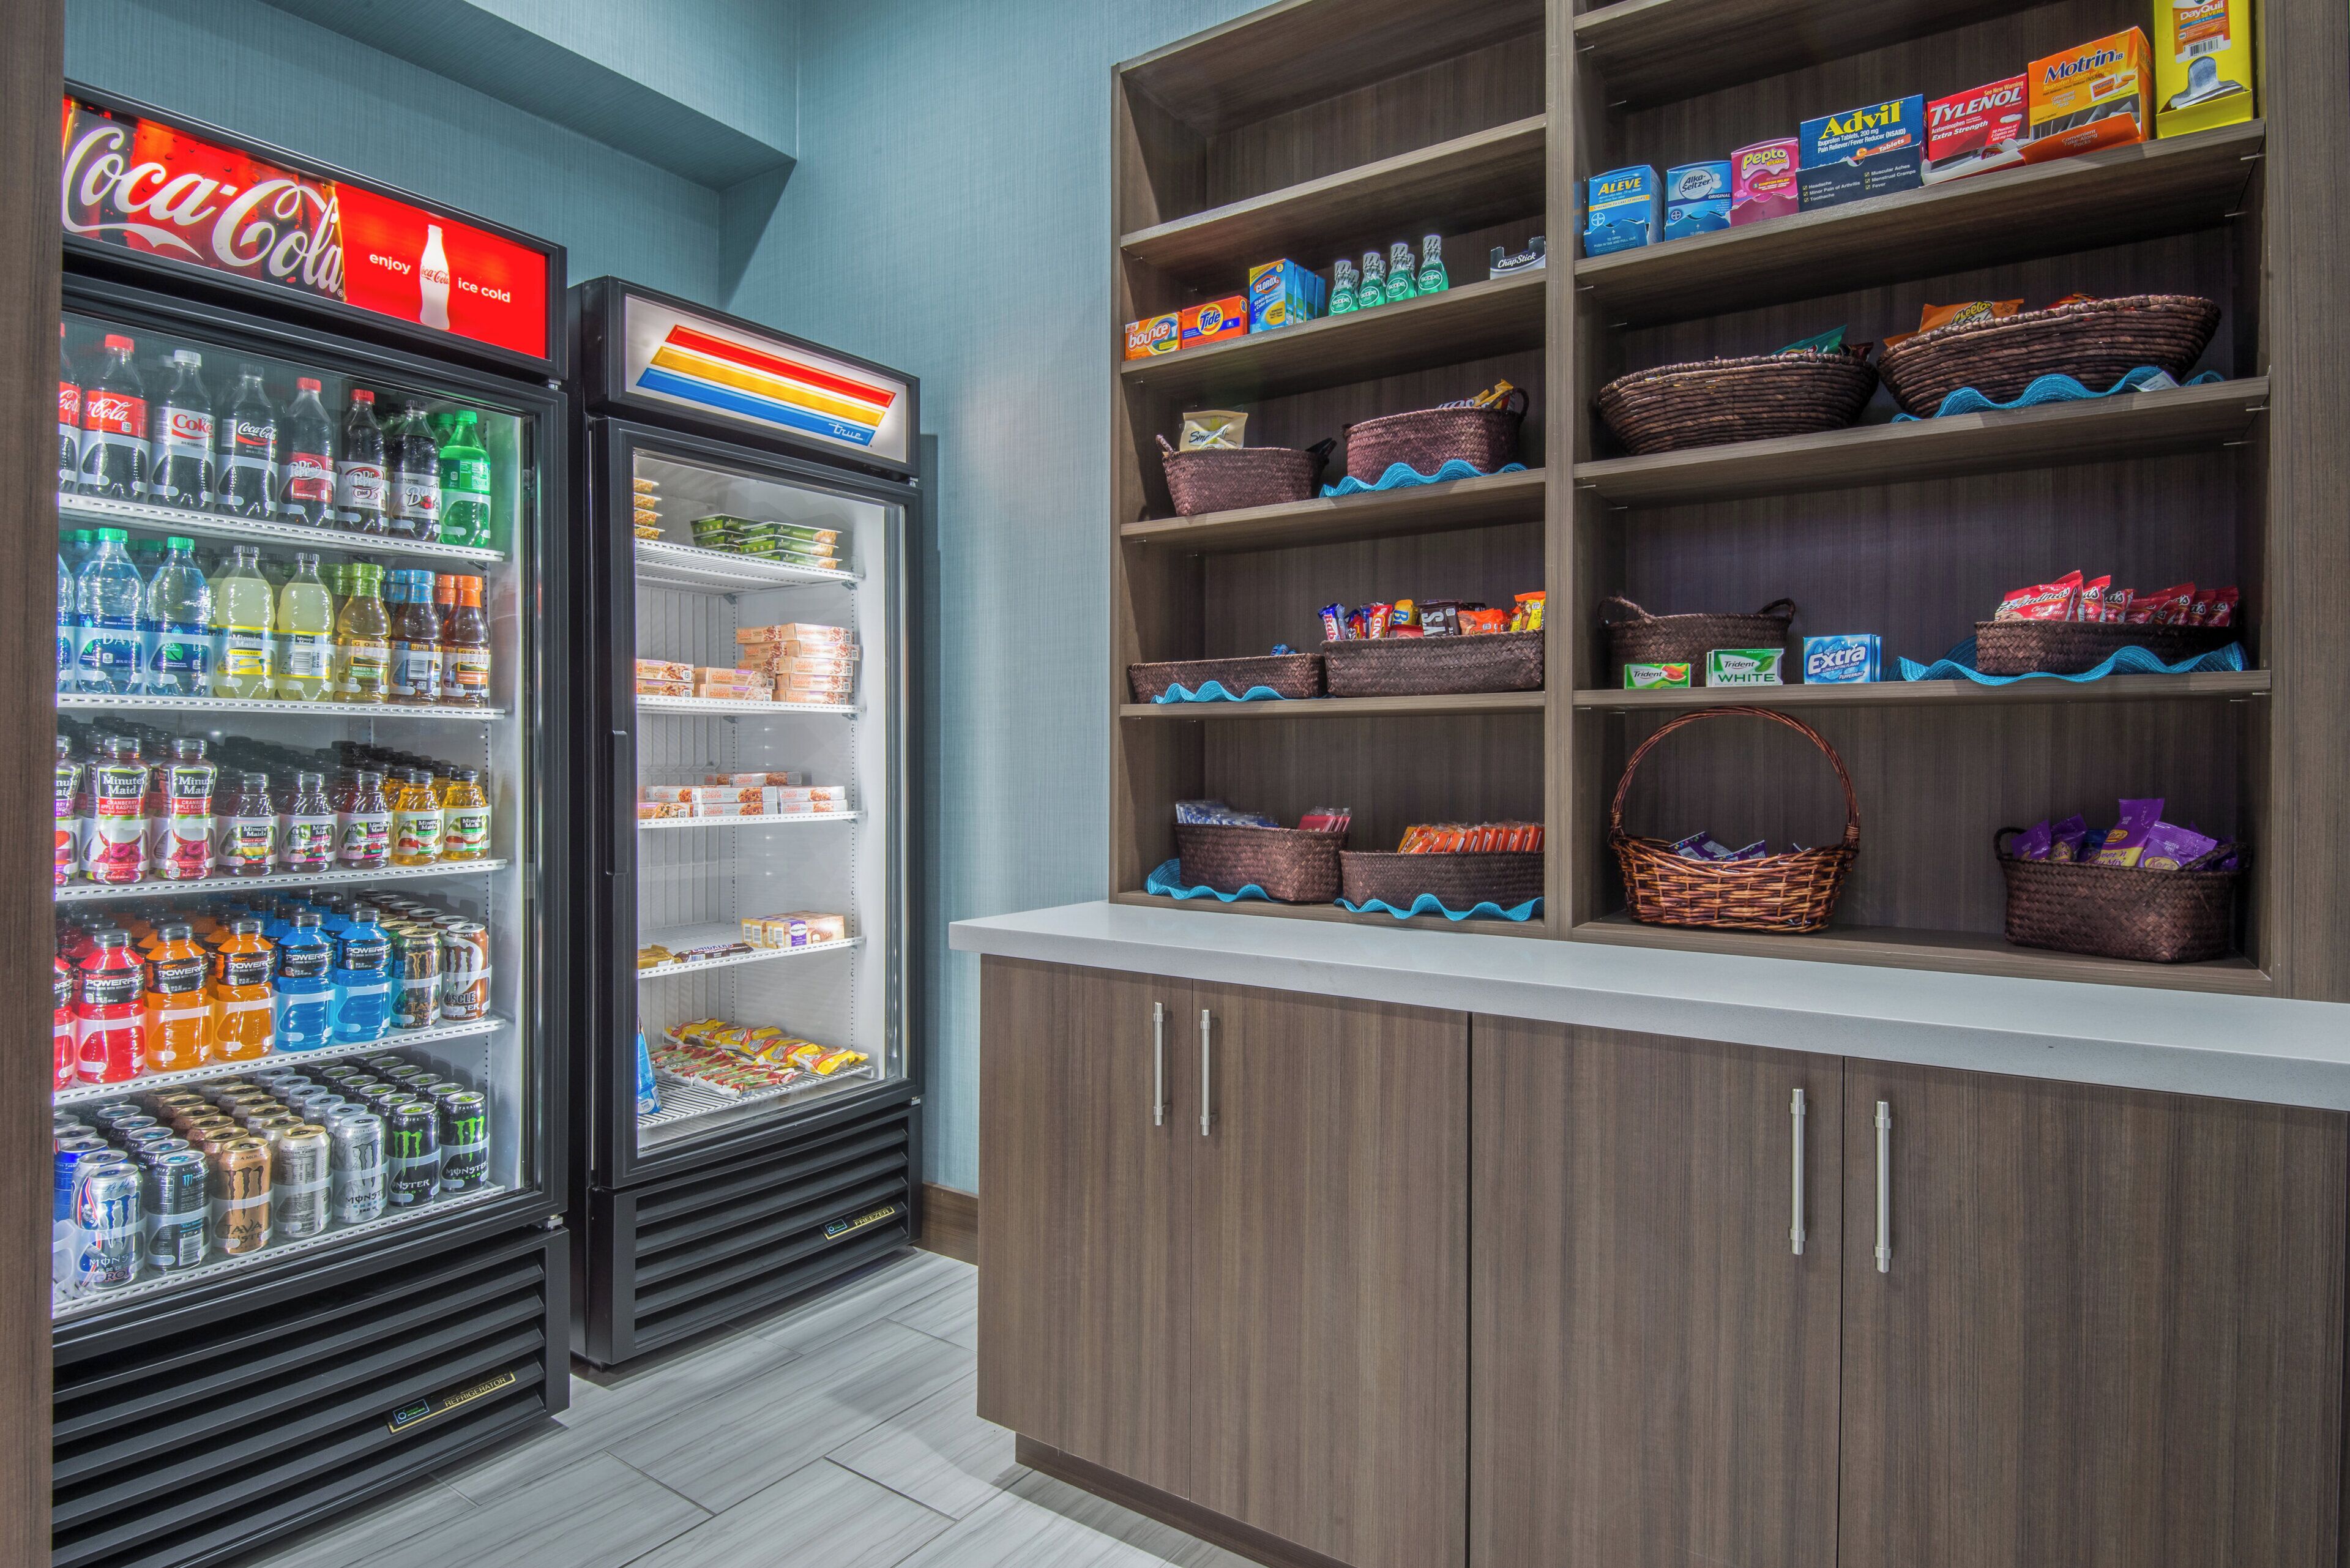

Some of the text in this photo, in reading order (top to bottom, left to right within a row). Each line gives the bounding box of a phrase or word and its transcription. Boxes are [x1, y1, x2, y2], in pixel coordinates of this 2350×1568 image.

[2180, 0, 2225, 21] DayQuil
[2201, 8, 2225, 18] SEVERE
[2044, 49, 2116, 84] Motrin
[2004, 80, 2024, 91] Warning
[2043, 72, 2091, 92] Ibuprofen Tablets
[2051, 90, 2075, 101] Convenient
[2051, 95, 2075, 106] Take-Along
[1930, 87, 2022, 128] TYLENOL
[1819, 100, 1901, 140] Advil
[1931, 119, 1966, 135] Acetaminophen
[1864, 134, 1885, 145] Reducer
[1886, 127, 1906, 139] (NSAID)
[1931, 130, 1952, 141] Extra
[1953, 120, 1988, 135] Strength
[2062, 129, 2096, 143] Convenient
[1818, 136, 1840, 147] Ibuprofen
[1841, 133, 1859, 142] Tablets,
[1879, 138, 1904, 152] Tablets
[2064, 133, 2098, 146] Take-Along
[2074, 139, 2092, 147] Packs
[1766, 158, 1787, 167] BISMOL
[1871, 166, 1894, 176] Muscular
[1871, 168, 1917, 182] Menstrual Cramps
[1597, 177, 1642, 196] ALEVE
[1681, 178, 1712, 193] Seltzer
[1683, 174, 1706, 186] Alka-
[1808, 181, 1832, 190] Headache
[1810, 193, 1835, 201] Toothache
[62, 126, 344, 293] Coca-Cola
[369, 253, 411, 275] enjoy
[1498, 252, 1537, 269] ChapStick
[420, 265, 450, 285] Coca-Cola
[1421, 274, 1439, 283] scope
[458, 277, 511, 303] ice cold
[1388, 281, 1405, 290] scope
[1332, 296, 1349, 305] scope
[1360, 289, 1377, 299] scope
[1254, 297, 1265, 307] Stain
[1256, 300, 1266, 310] Color
[1200, 310, 1221, 332] Tide
[1128, 323, 1168, 350] bounce
[173, 414, 214, 435] Coke
[237, 422, 277, 441] Coca-Cola
[828, 422, 864, 441] true
[290, 461, 320, 476] Pepper
[352, 472, 381, 486] Pepper
[354, 646, 386, 657] PEAK
[1808, 646, 1867, 675] Extra
[1718, 673, 1775, 682] WHITE
[1838, 671, 1865, 680] PEPPERMINT
[102, 775, 143, 785] Minute
[179, 776, 214, 785] Minute
[108, 785, 137, 794] Maid
[183, 785, 210, 794] Maid
[2165, 840, 2180, 849] GLUTEN
[2148, 857, 2176, 869] Kar's
[286, 950, 334, 961] POWERADE
[346, 944, 392, 954] POWERADE
[85, 973, 144, 987] POWERADE
[446, 991, 476, 1004] USCLE
[446, 1162, 488, 1176] MONSTER
[854, 1209, 890, 1226] FREEZER
[225, 1218, 263, 1236] JAVA
[444, 1376, 506, 1408] REFRIGERATOR
